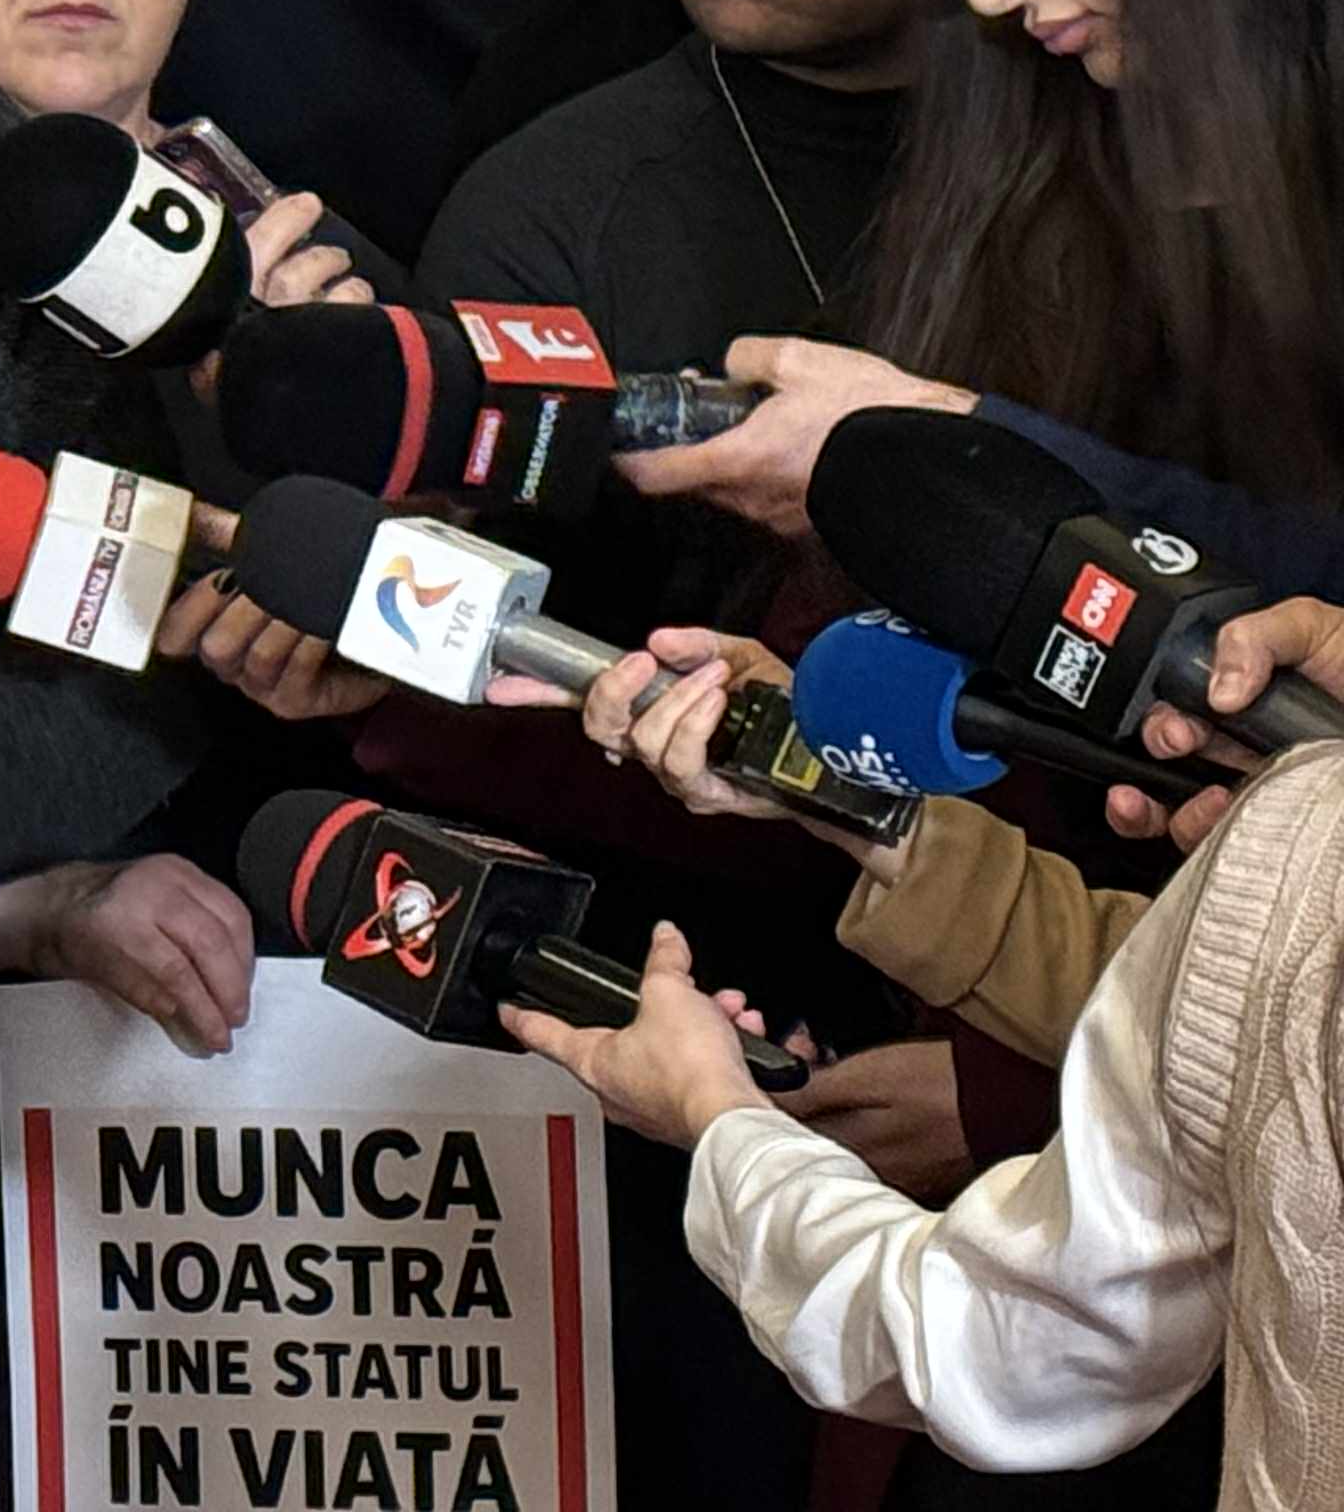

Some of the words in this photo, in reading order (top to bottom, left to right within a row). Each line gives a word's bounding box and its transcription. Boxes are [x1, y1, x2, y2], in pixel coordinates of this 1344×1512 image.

[442, 599, 478, 650] TVR
[98, 1126, 502, 1221] MUNCA
[273, 1341, 520, 1402] STATUL
